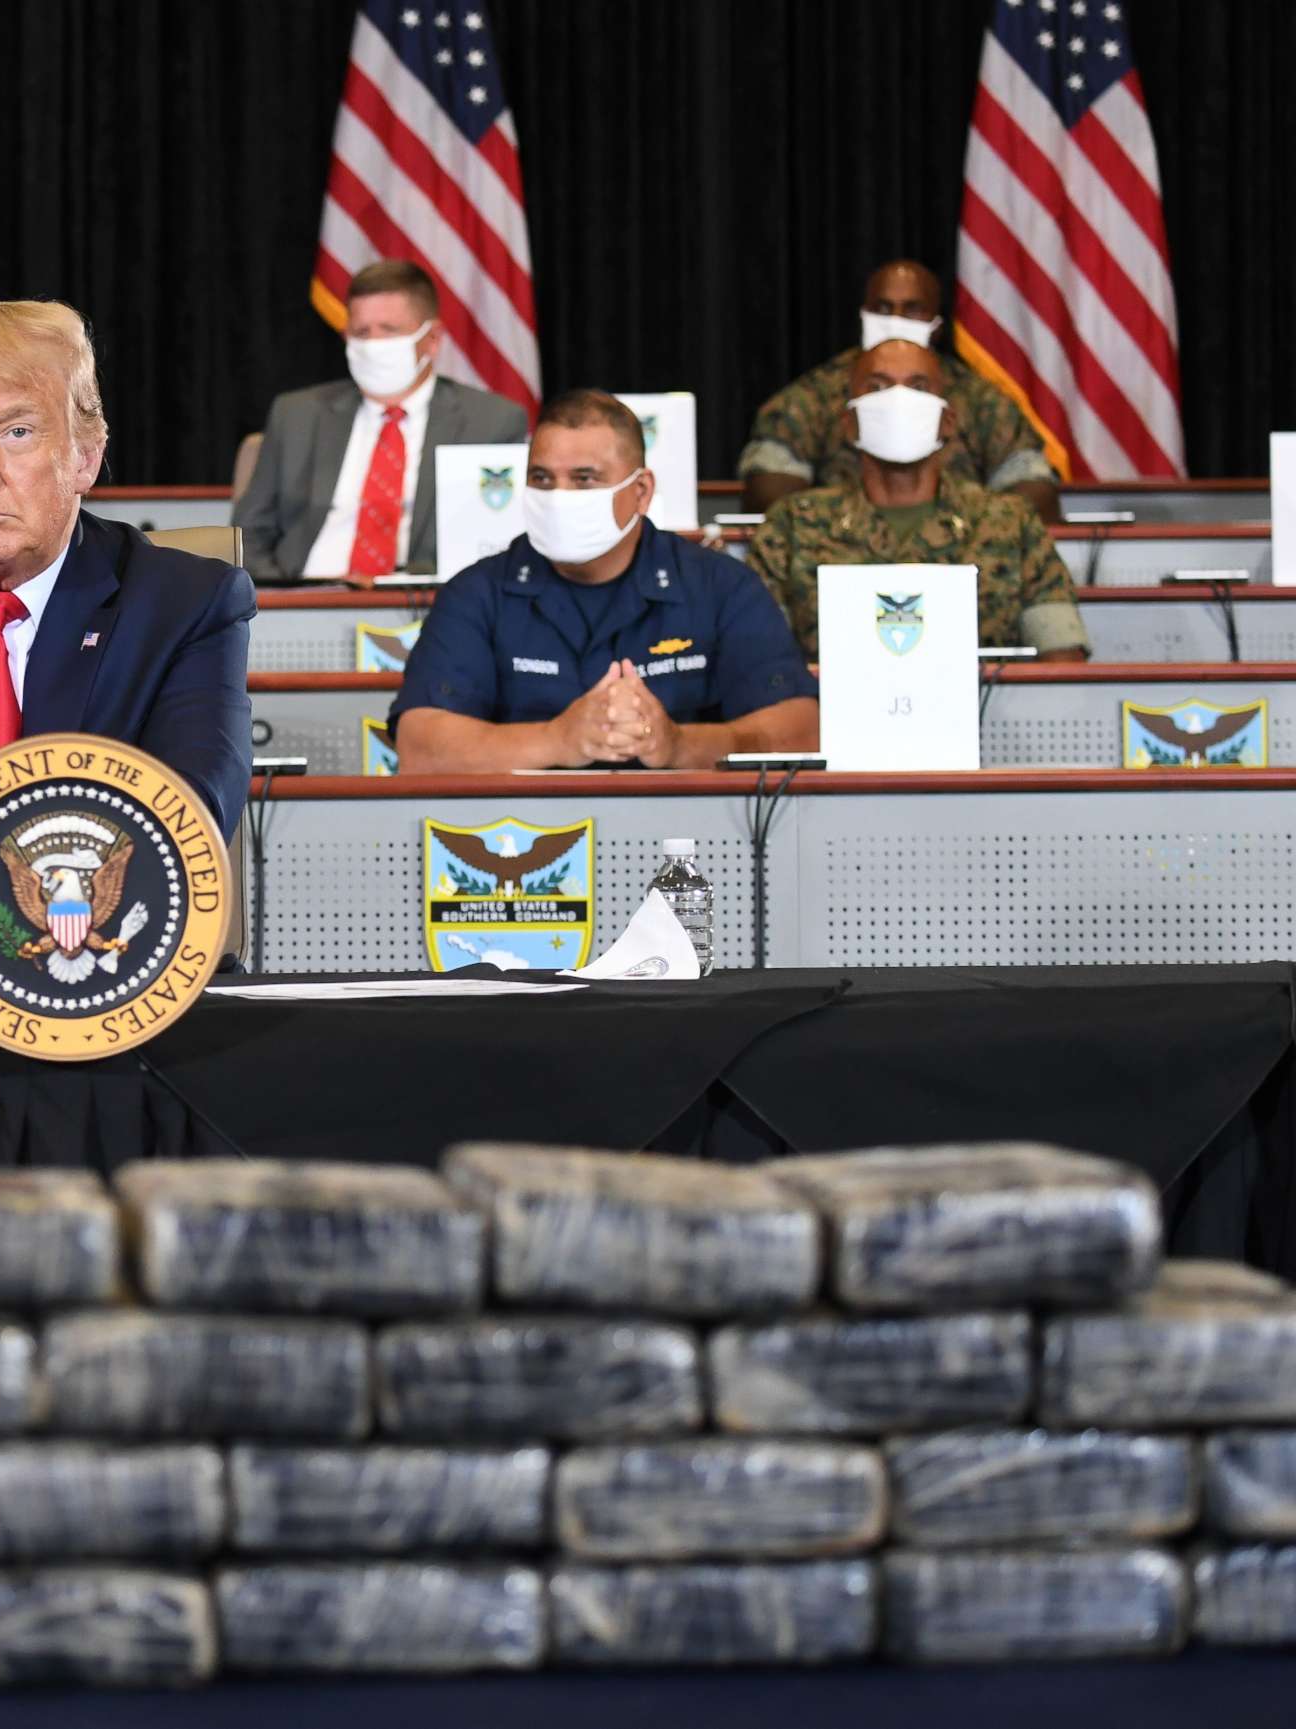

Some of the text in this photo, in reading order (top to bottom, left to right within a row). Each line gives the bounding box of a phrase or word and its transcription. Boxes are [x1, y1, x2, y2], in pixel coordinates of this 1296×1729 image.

[888, 696, 913, 717] J3
[66, 750, 96, 770] OF
[103, 756, 143, 787] THE
[152, 785, 219, 913] UNITED
[441, 911, 577, 922] SOUTHERN COMMAND
[460, 901, 558, 912] UNITED STATES
[101, 943, 207, 1043] STATES
